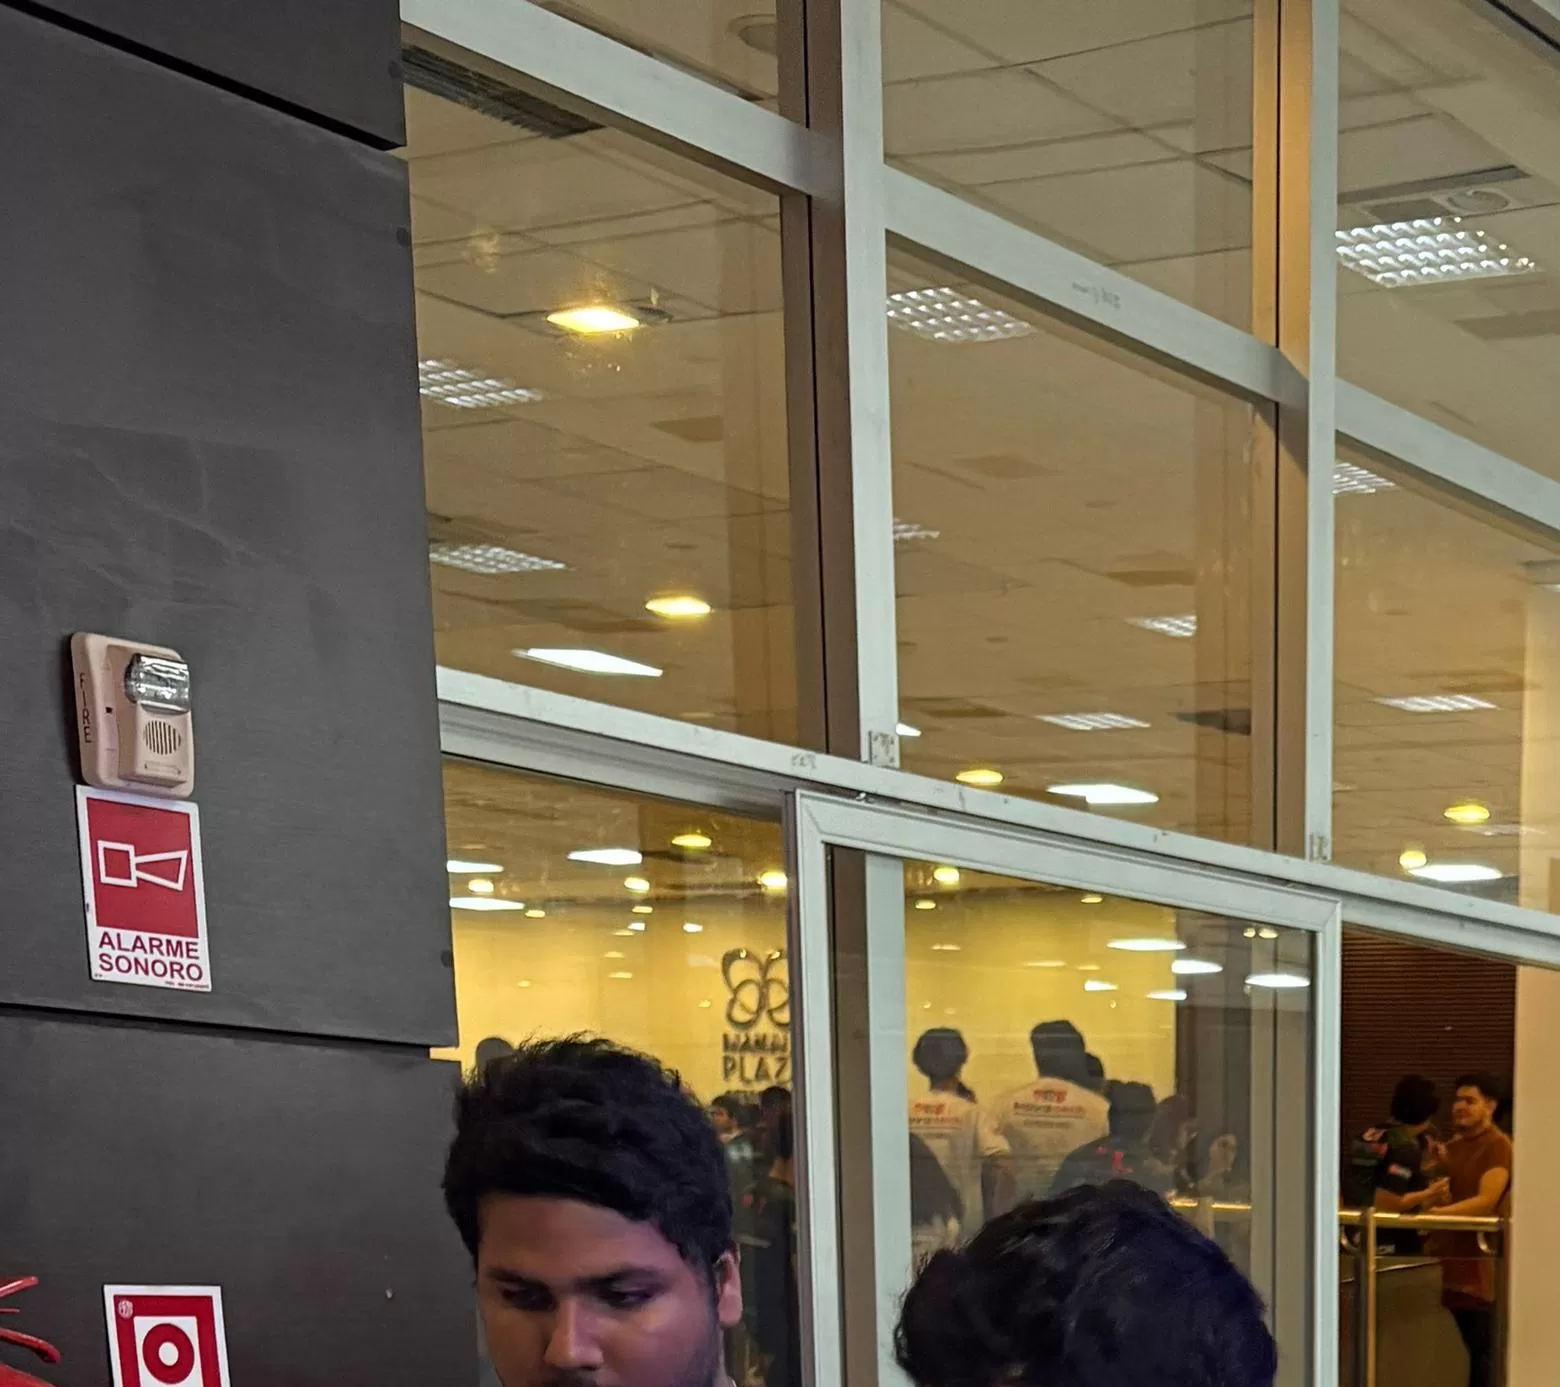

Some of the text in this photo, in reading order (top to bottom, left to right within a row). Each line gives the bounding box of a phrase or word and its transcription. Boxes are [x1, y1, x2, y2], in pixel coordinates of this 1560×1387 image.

[99, 932, 200, 960] ALARME
[99, 953, 203, 981] SONORO
[723, 1055, 790, 1084] PLAZ
